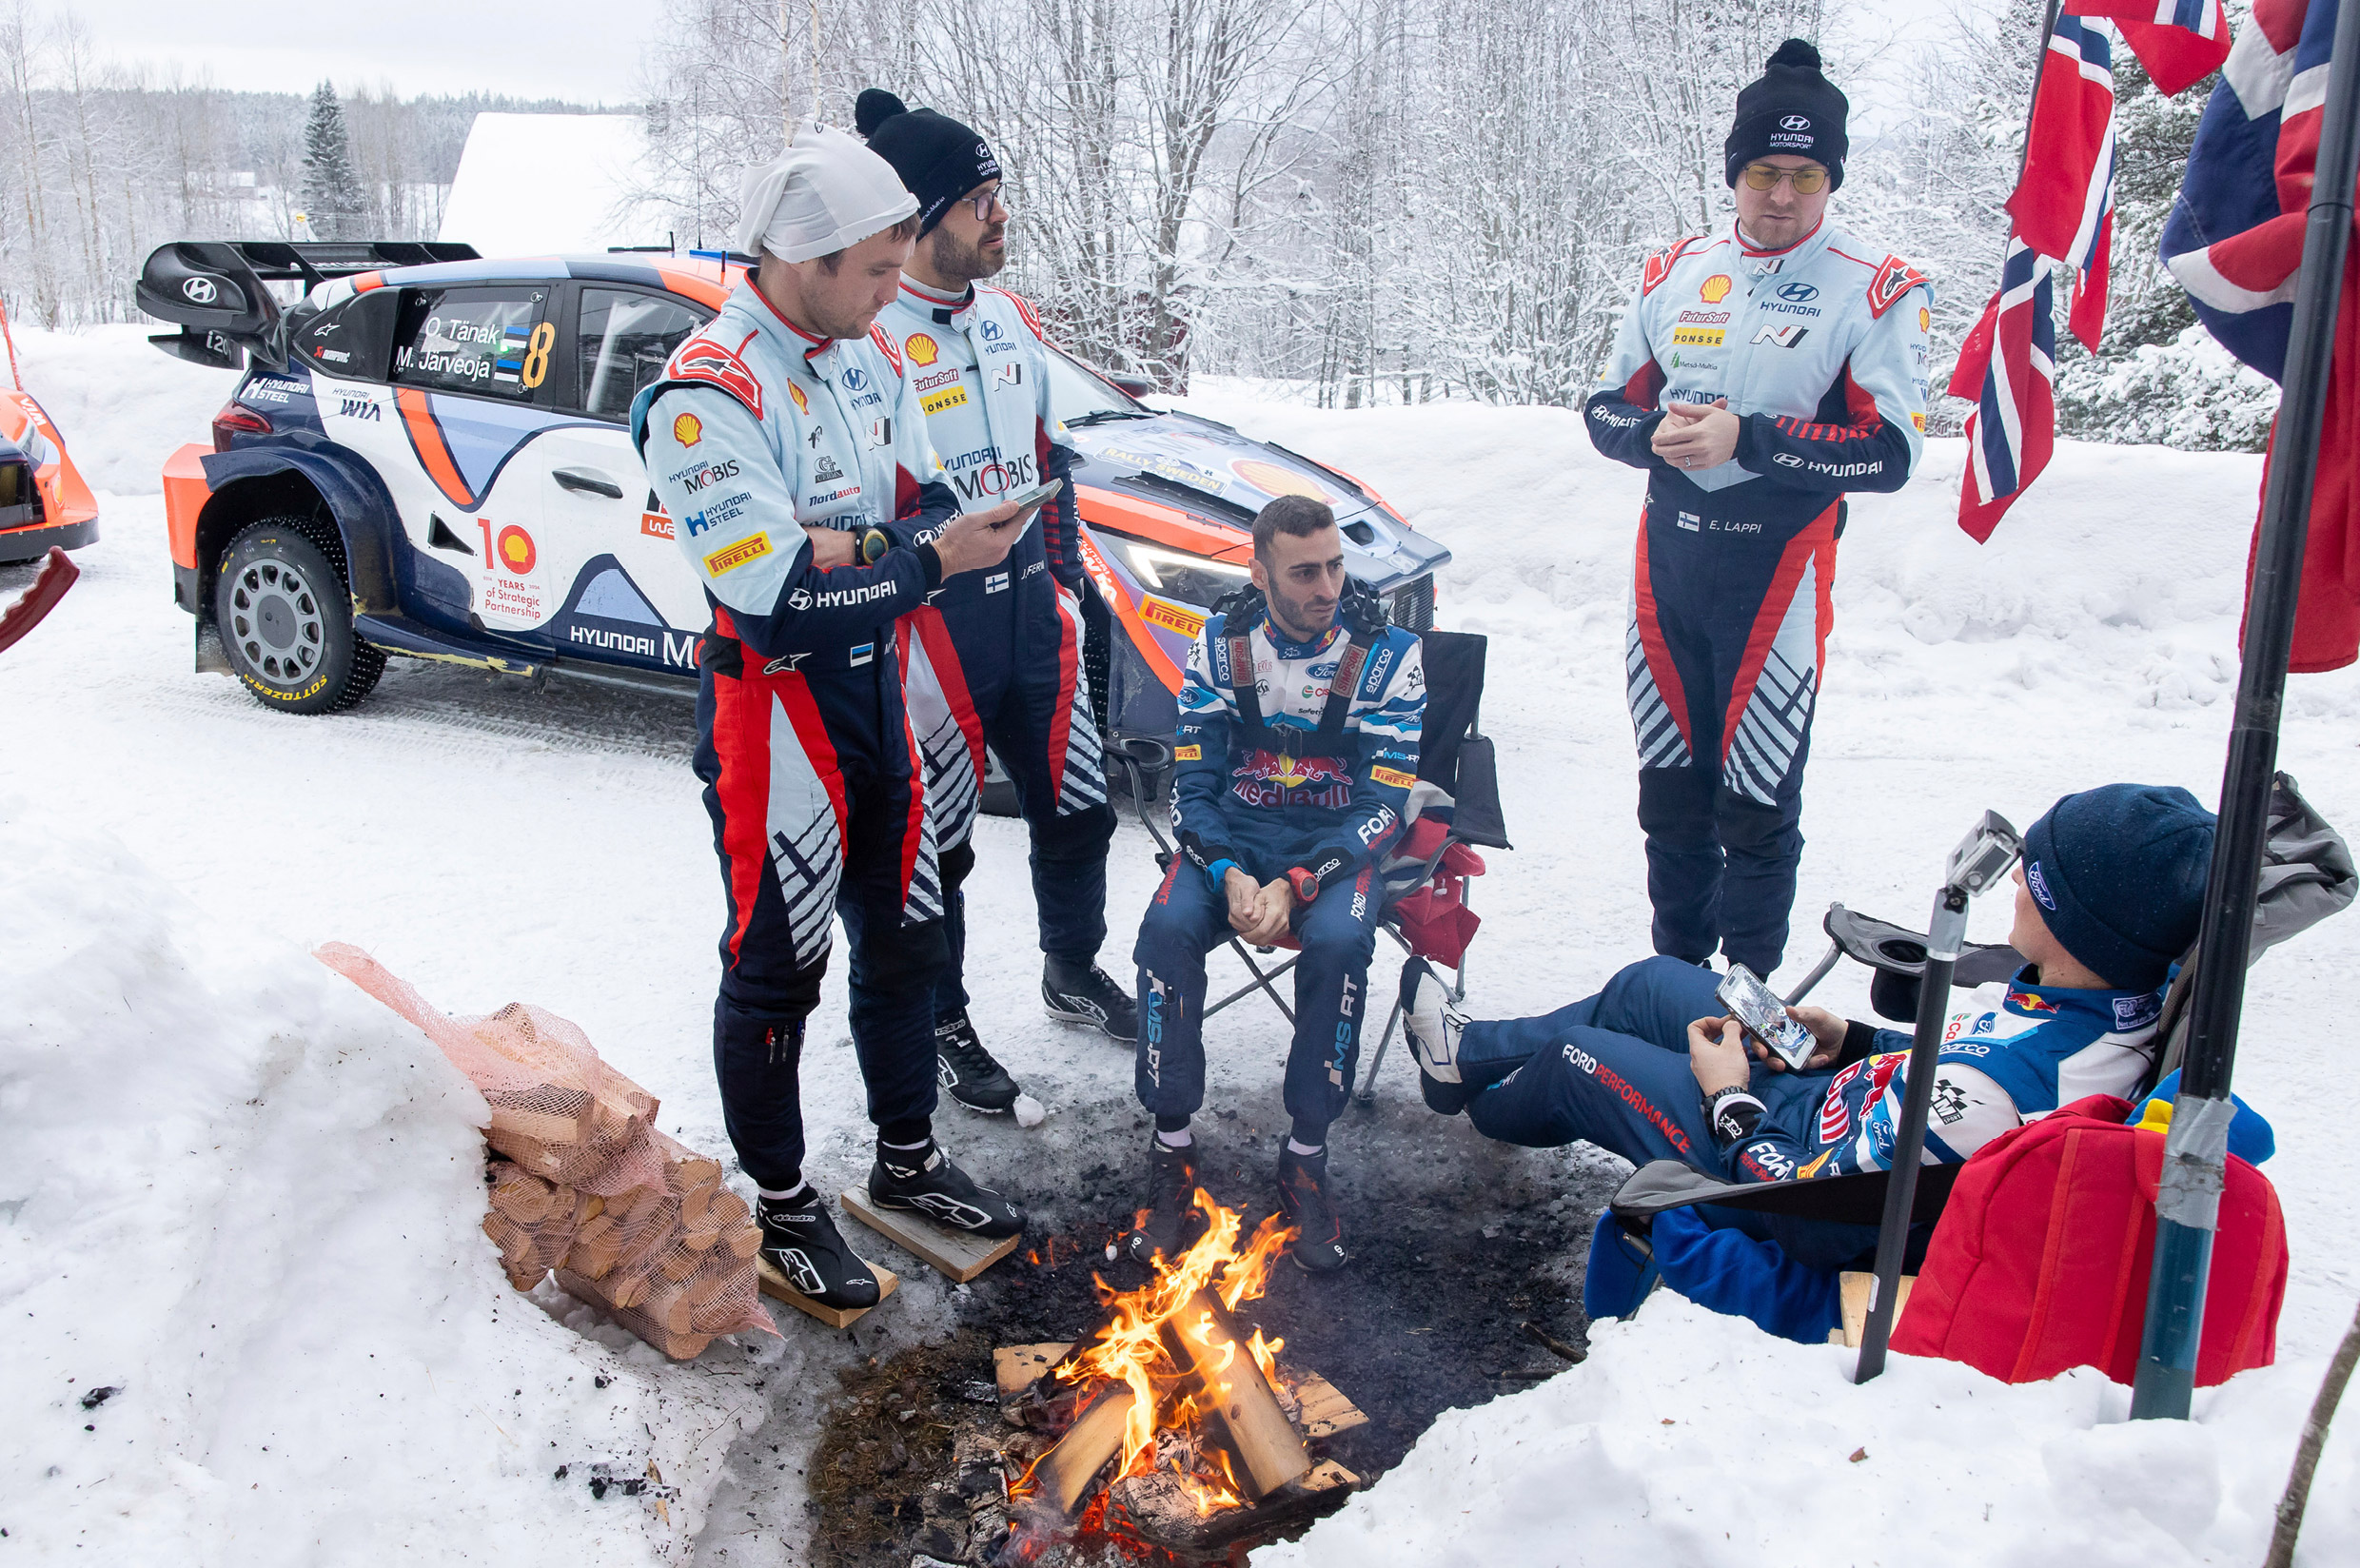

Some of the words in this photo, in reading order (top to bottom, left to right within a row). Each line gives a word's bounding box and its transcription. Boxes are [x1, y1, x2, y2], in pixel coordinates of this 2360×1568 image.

[1770, 132, 1815, 144] HYUNDAI
[1678, 310, 1731, 323] FuturSoft
[1760, 302, 1821, 317] HYUNDAI
[448, 318, 501, 345] Tänak
[1673, 334, 1722, 344] PONSSE
[522, 321, 556, 389] 8
[985, 342, 1017, 356] YUNDAI
[395, 345, 416, 369] M.
[417, 349, 492, 382] Järveoja
[257, 389, 290, 403] STEEL
[264, 378, 311, 394] HYUNDAI
[332, 387, 371, 400] HYUNDAI
[339, 399, 382, 422] WIA
[942, 445, 1002, 472] YUNDAI
[1105, 448, 1153, 466] RALLY
[1154, 462, 1221, 490] SWEDEN
[1808, 461, 1883, 478] HYUNDAI
[668, 460, 710, 483] HYUNDAI
[683, 459, 740, 495] MOBIS
[953, 454, 1033, 503] MOBIS
[704, 491, 753, 518] HYUNDAI
[709, 507, 744, 527] STEEL
[1708, 520, 1721, 532] E.
[1724, 522, 1762, 534] LAPPI
[708, 537, 766, 573] PIRELLI
[498, 578, 525, 592] YEARS
[816, 579, 897, 609] HYUNDAI
[484, 598, 541, 620] Partnership
[486, 587, 496, 598] of
[498, 589, 541, 608] Strategic
[571, 625, 656, 657] HYUNDAI
[1338, 649, 1362, 692] SIMPSON
[1366, 648, 1394, 696] sparco
[2030, 871, 2051, 904] Ford
